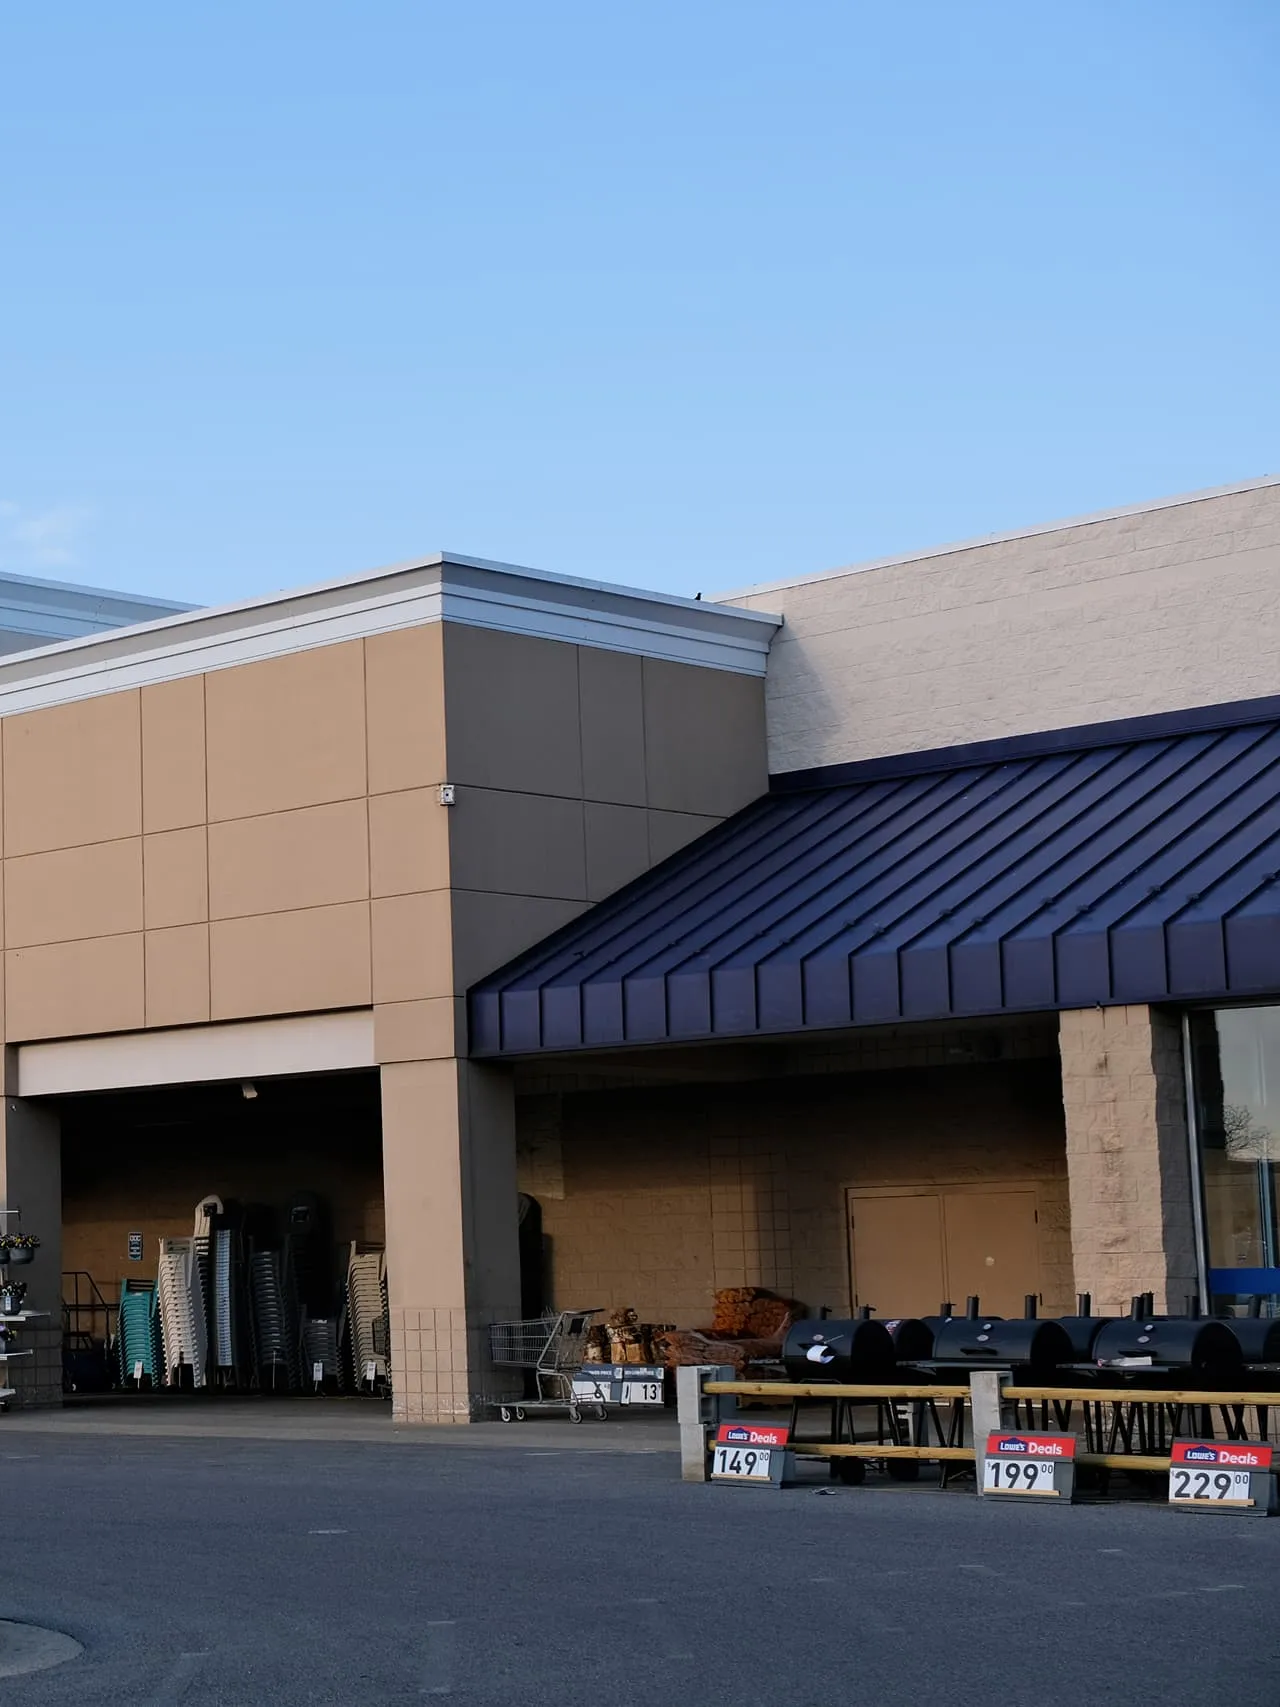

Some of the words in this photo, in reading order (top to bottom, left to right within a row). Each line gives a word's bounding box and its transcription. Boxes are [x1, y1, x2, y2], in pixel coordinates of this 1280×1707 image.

[749, 1432, 777, 1444] Deals
[999, 1441, 1025, 1451] LOWE'S
[1028, 1442, 1063, 1455] Deals
[1186, 1450, 1217, 1461] LOWE'S
[1219, 1451, 1258, 1465] Deals
